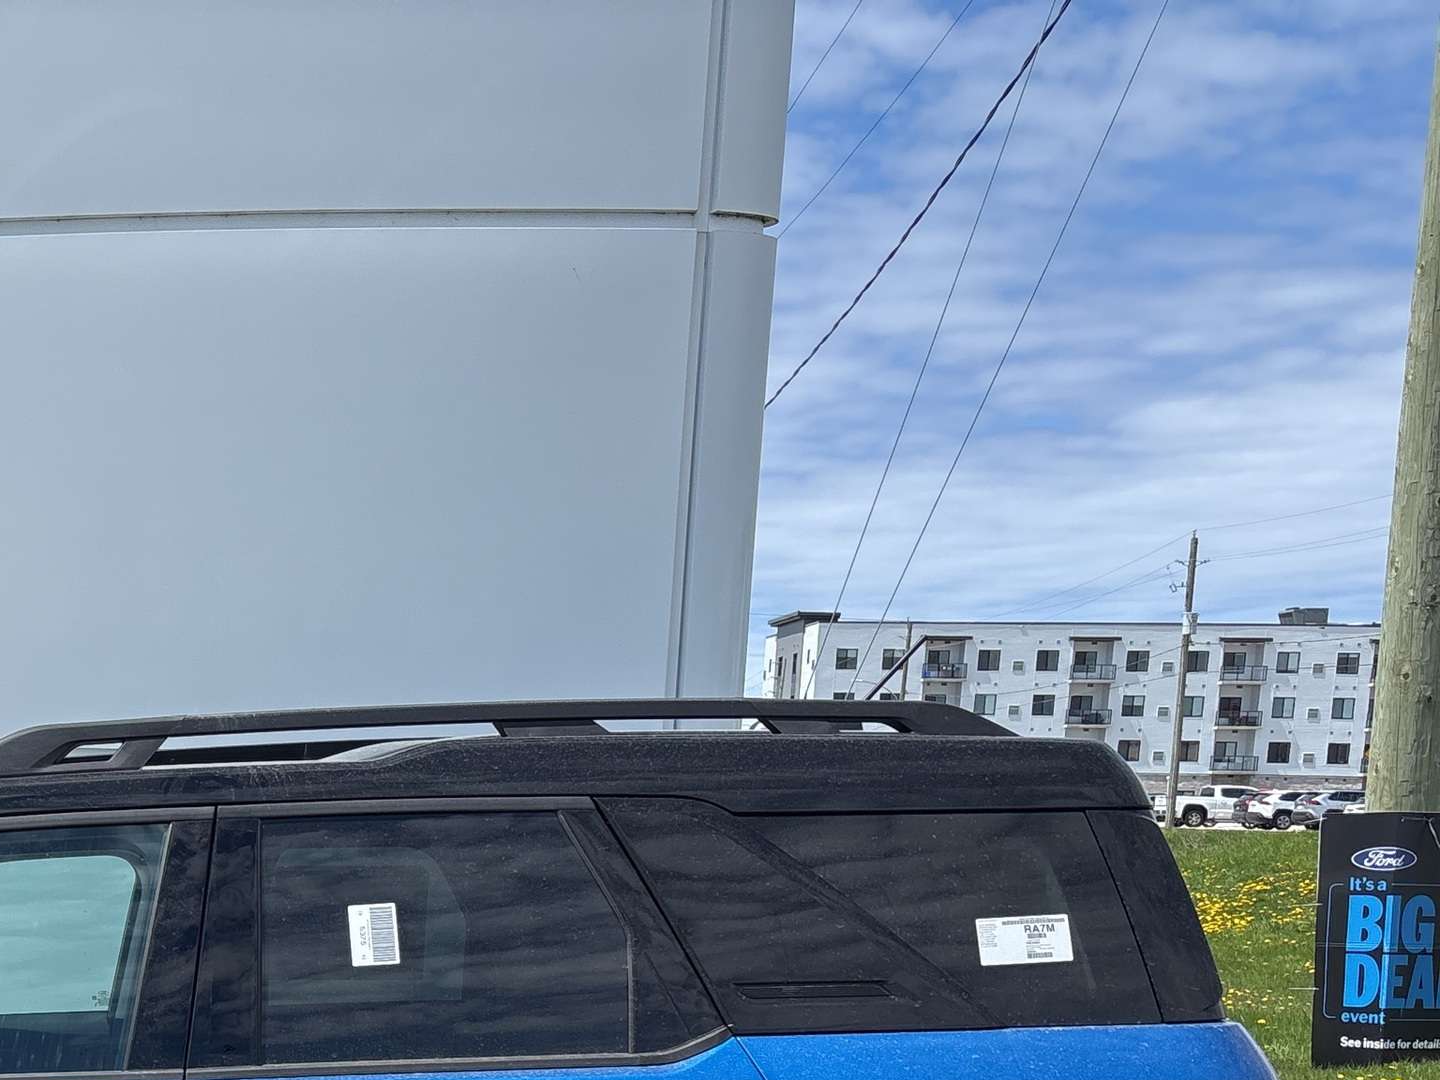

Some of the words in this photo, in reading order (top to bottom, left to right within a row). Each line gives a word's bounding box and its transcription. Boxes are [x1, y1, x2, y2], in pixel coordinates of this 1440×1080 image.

[1349, 876, 1375, 891] It's
[1377, 880, 1387, 891] a
[1024, 924, 1055, 933] RA7M
[1346, 894, 1436, 952] BIG
[1342, 953, 1440, 1009] DEA
[1340, 1011, 1386, 1025] event
[1339, 1036, 1361, 1048] See
[1363, 1037, 1396, 1049] inside
[1397, 1039, 1411, 1049] for
